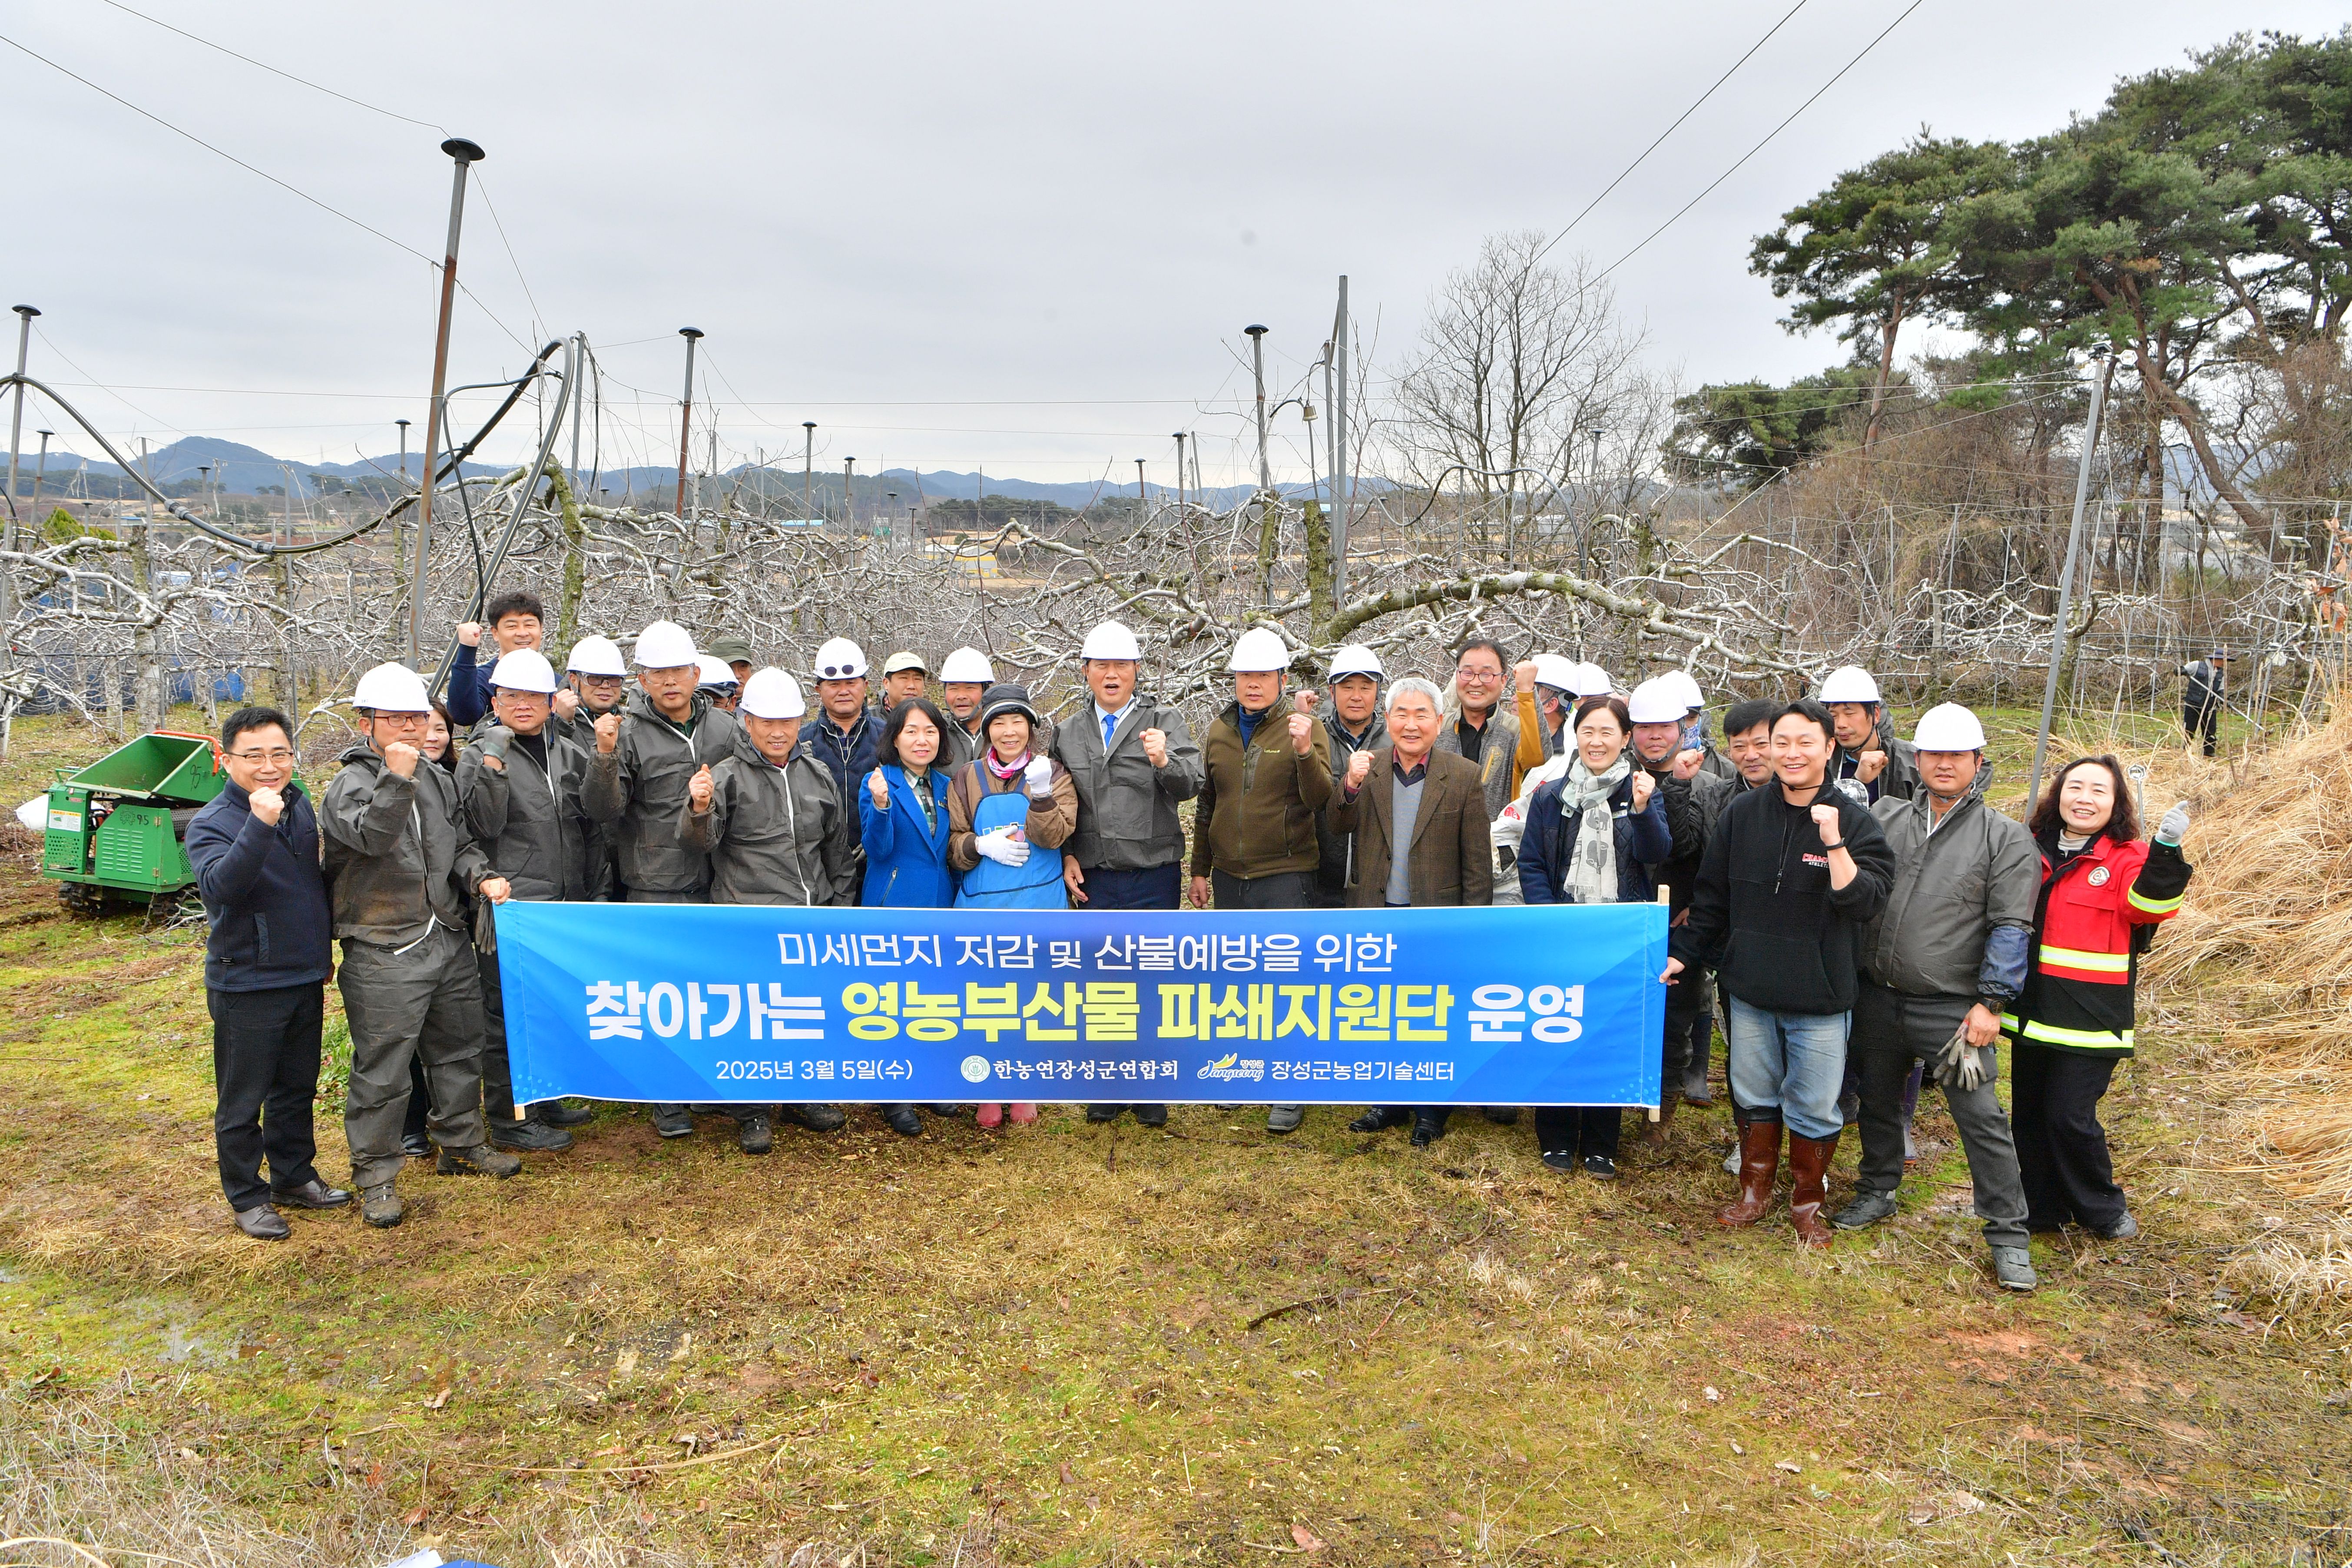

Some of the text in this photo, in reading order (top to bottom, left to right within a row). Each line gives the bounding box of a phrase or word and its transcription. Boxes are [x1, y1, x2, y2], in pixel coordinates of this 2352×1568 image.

[190, 764, 202, 792] 95
[136, 814, 149, 825] 95
[777, 933, 1397, 972] 미세먼지 저감 및 산불예방을 위한
[586, 980, 1585, 1043] 찾아가는 영농부산물 파쇄지원단 운영
[716, 1060, 913, 1081] 2025년 3월 5일(수)
[993, 1060, 1178, 1081] 한농연장성군연합회
[1197, 1060, 1265, 1082] Jangseong
[1240, 1060, 1265, 1069] 장성군
[1271, 1061, 1454, 1081] 장성군농업기술센터
